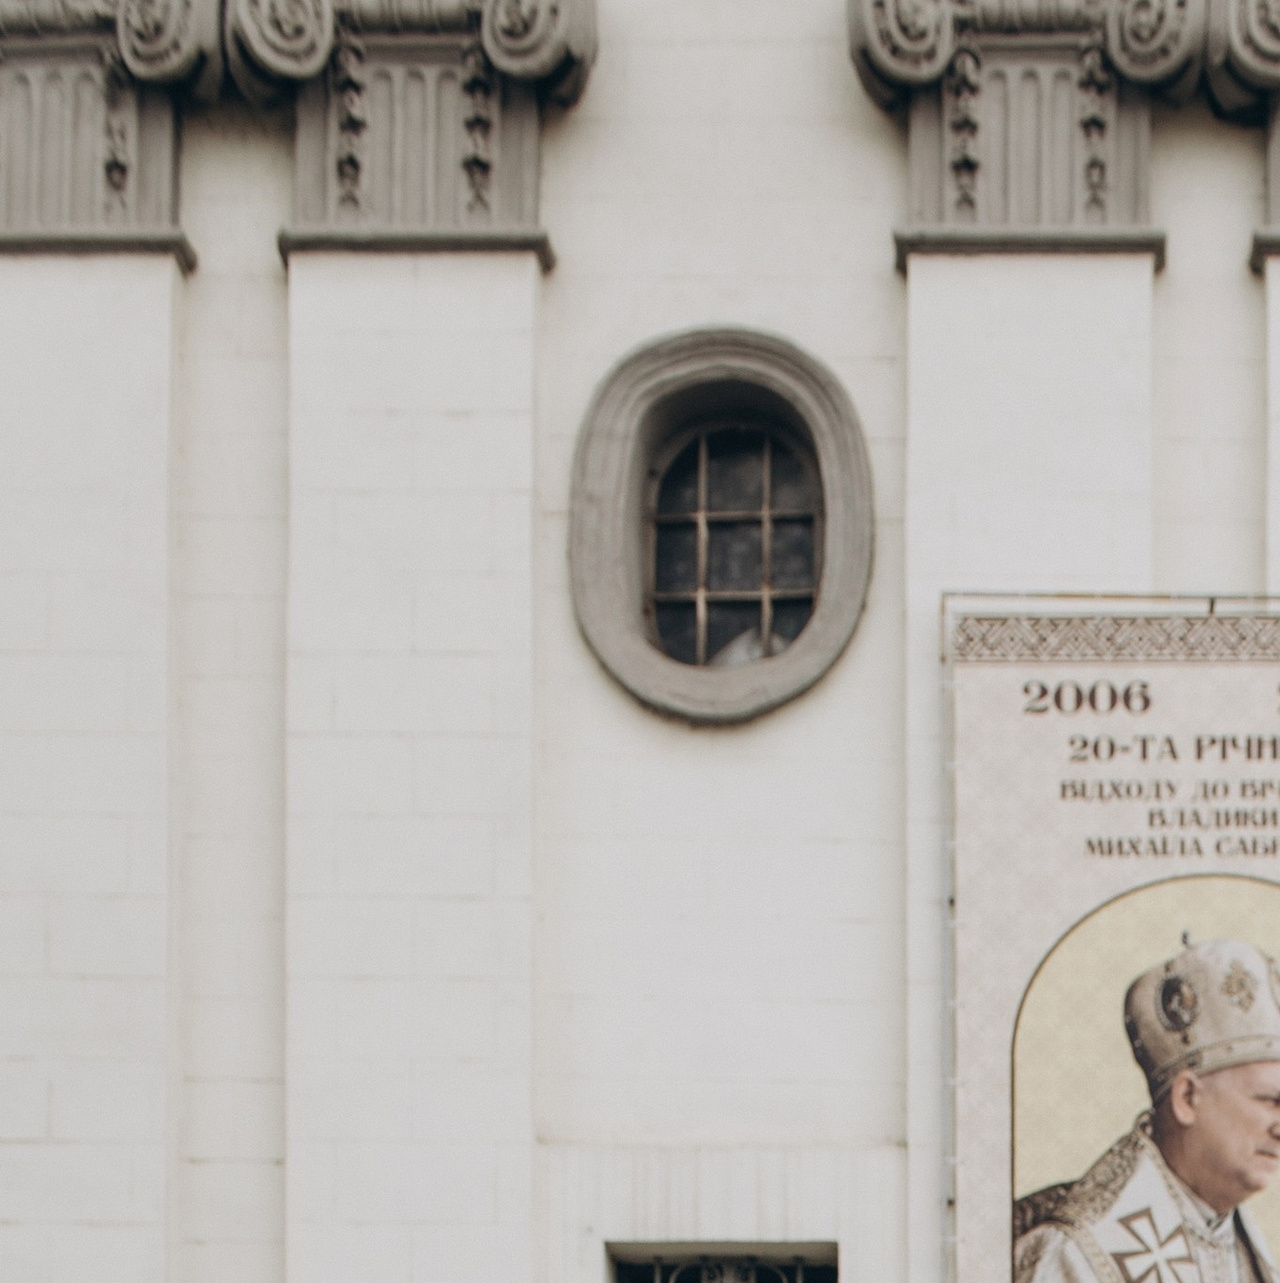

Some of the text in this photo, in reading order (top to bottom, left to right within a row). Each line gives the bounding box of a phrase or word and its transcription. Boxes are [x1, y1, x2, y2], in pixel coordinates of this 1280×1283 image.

[1022, 680, 1152, 714] 2006
[1067, 735, 1179, 762] 20-ТА
[1192, 779, 1230, 802] ДО
